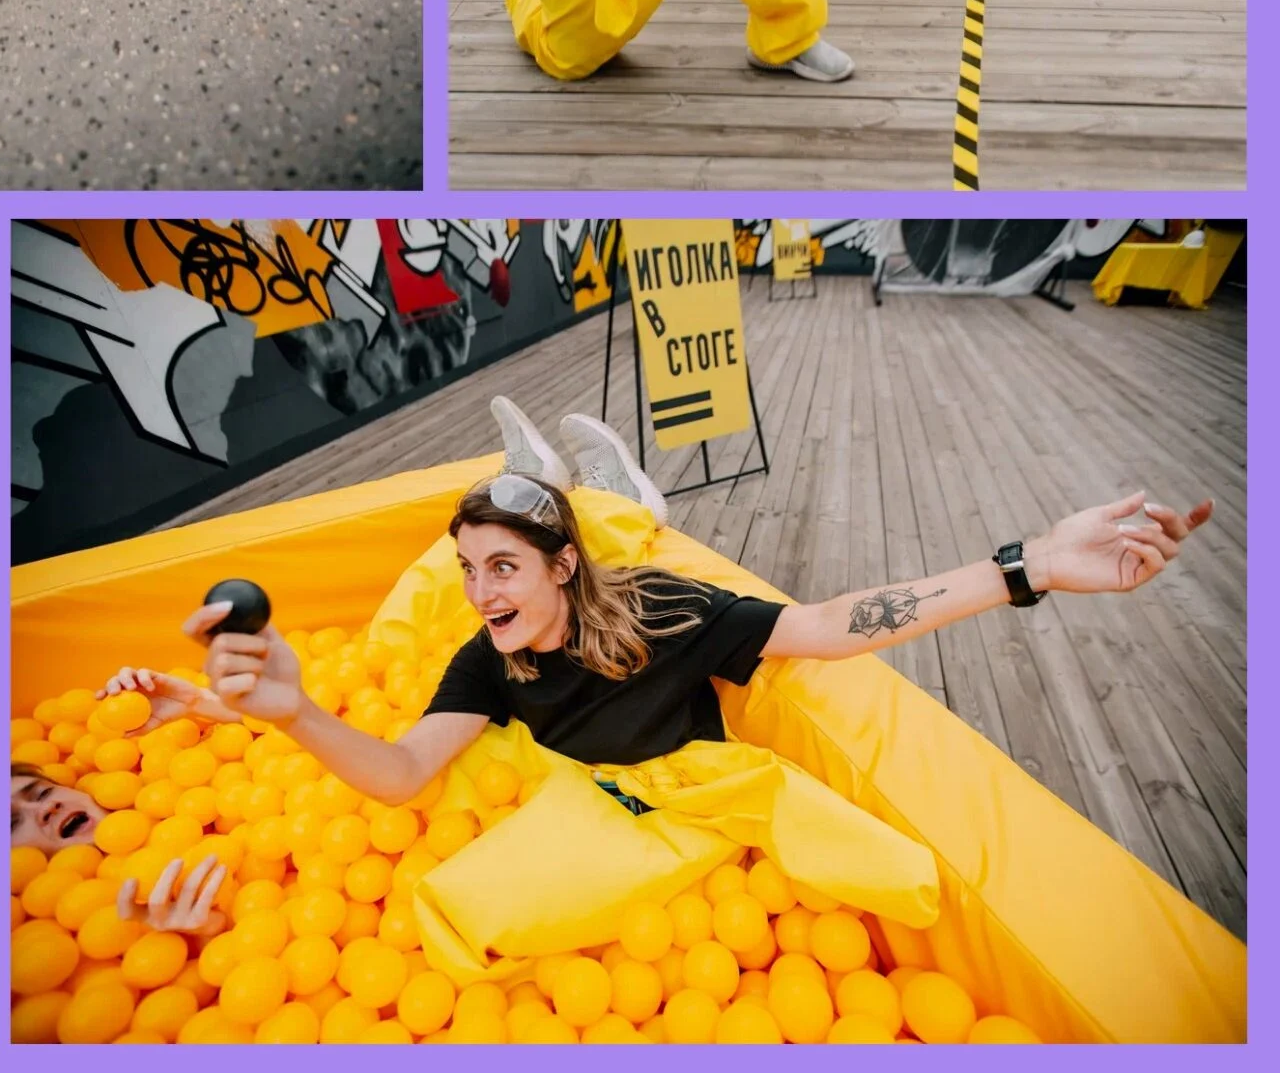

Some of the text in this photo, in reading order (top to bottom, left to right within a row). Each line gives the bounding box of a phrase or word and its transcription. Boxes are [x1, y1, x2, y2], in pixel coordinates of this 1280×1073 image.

[633, 240, 734, 292] ИГОЛКА
[641, 298, 666, 338] В
[666, 328, 738, 377] СТОГЕ
